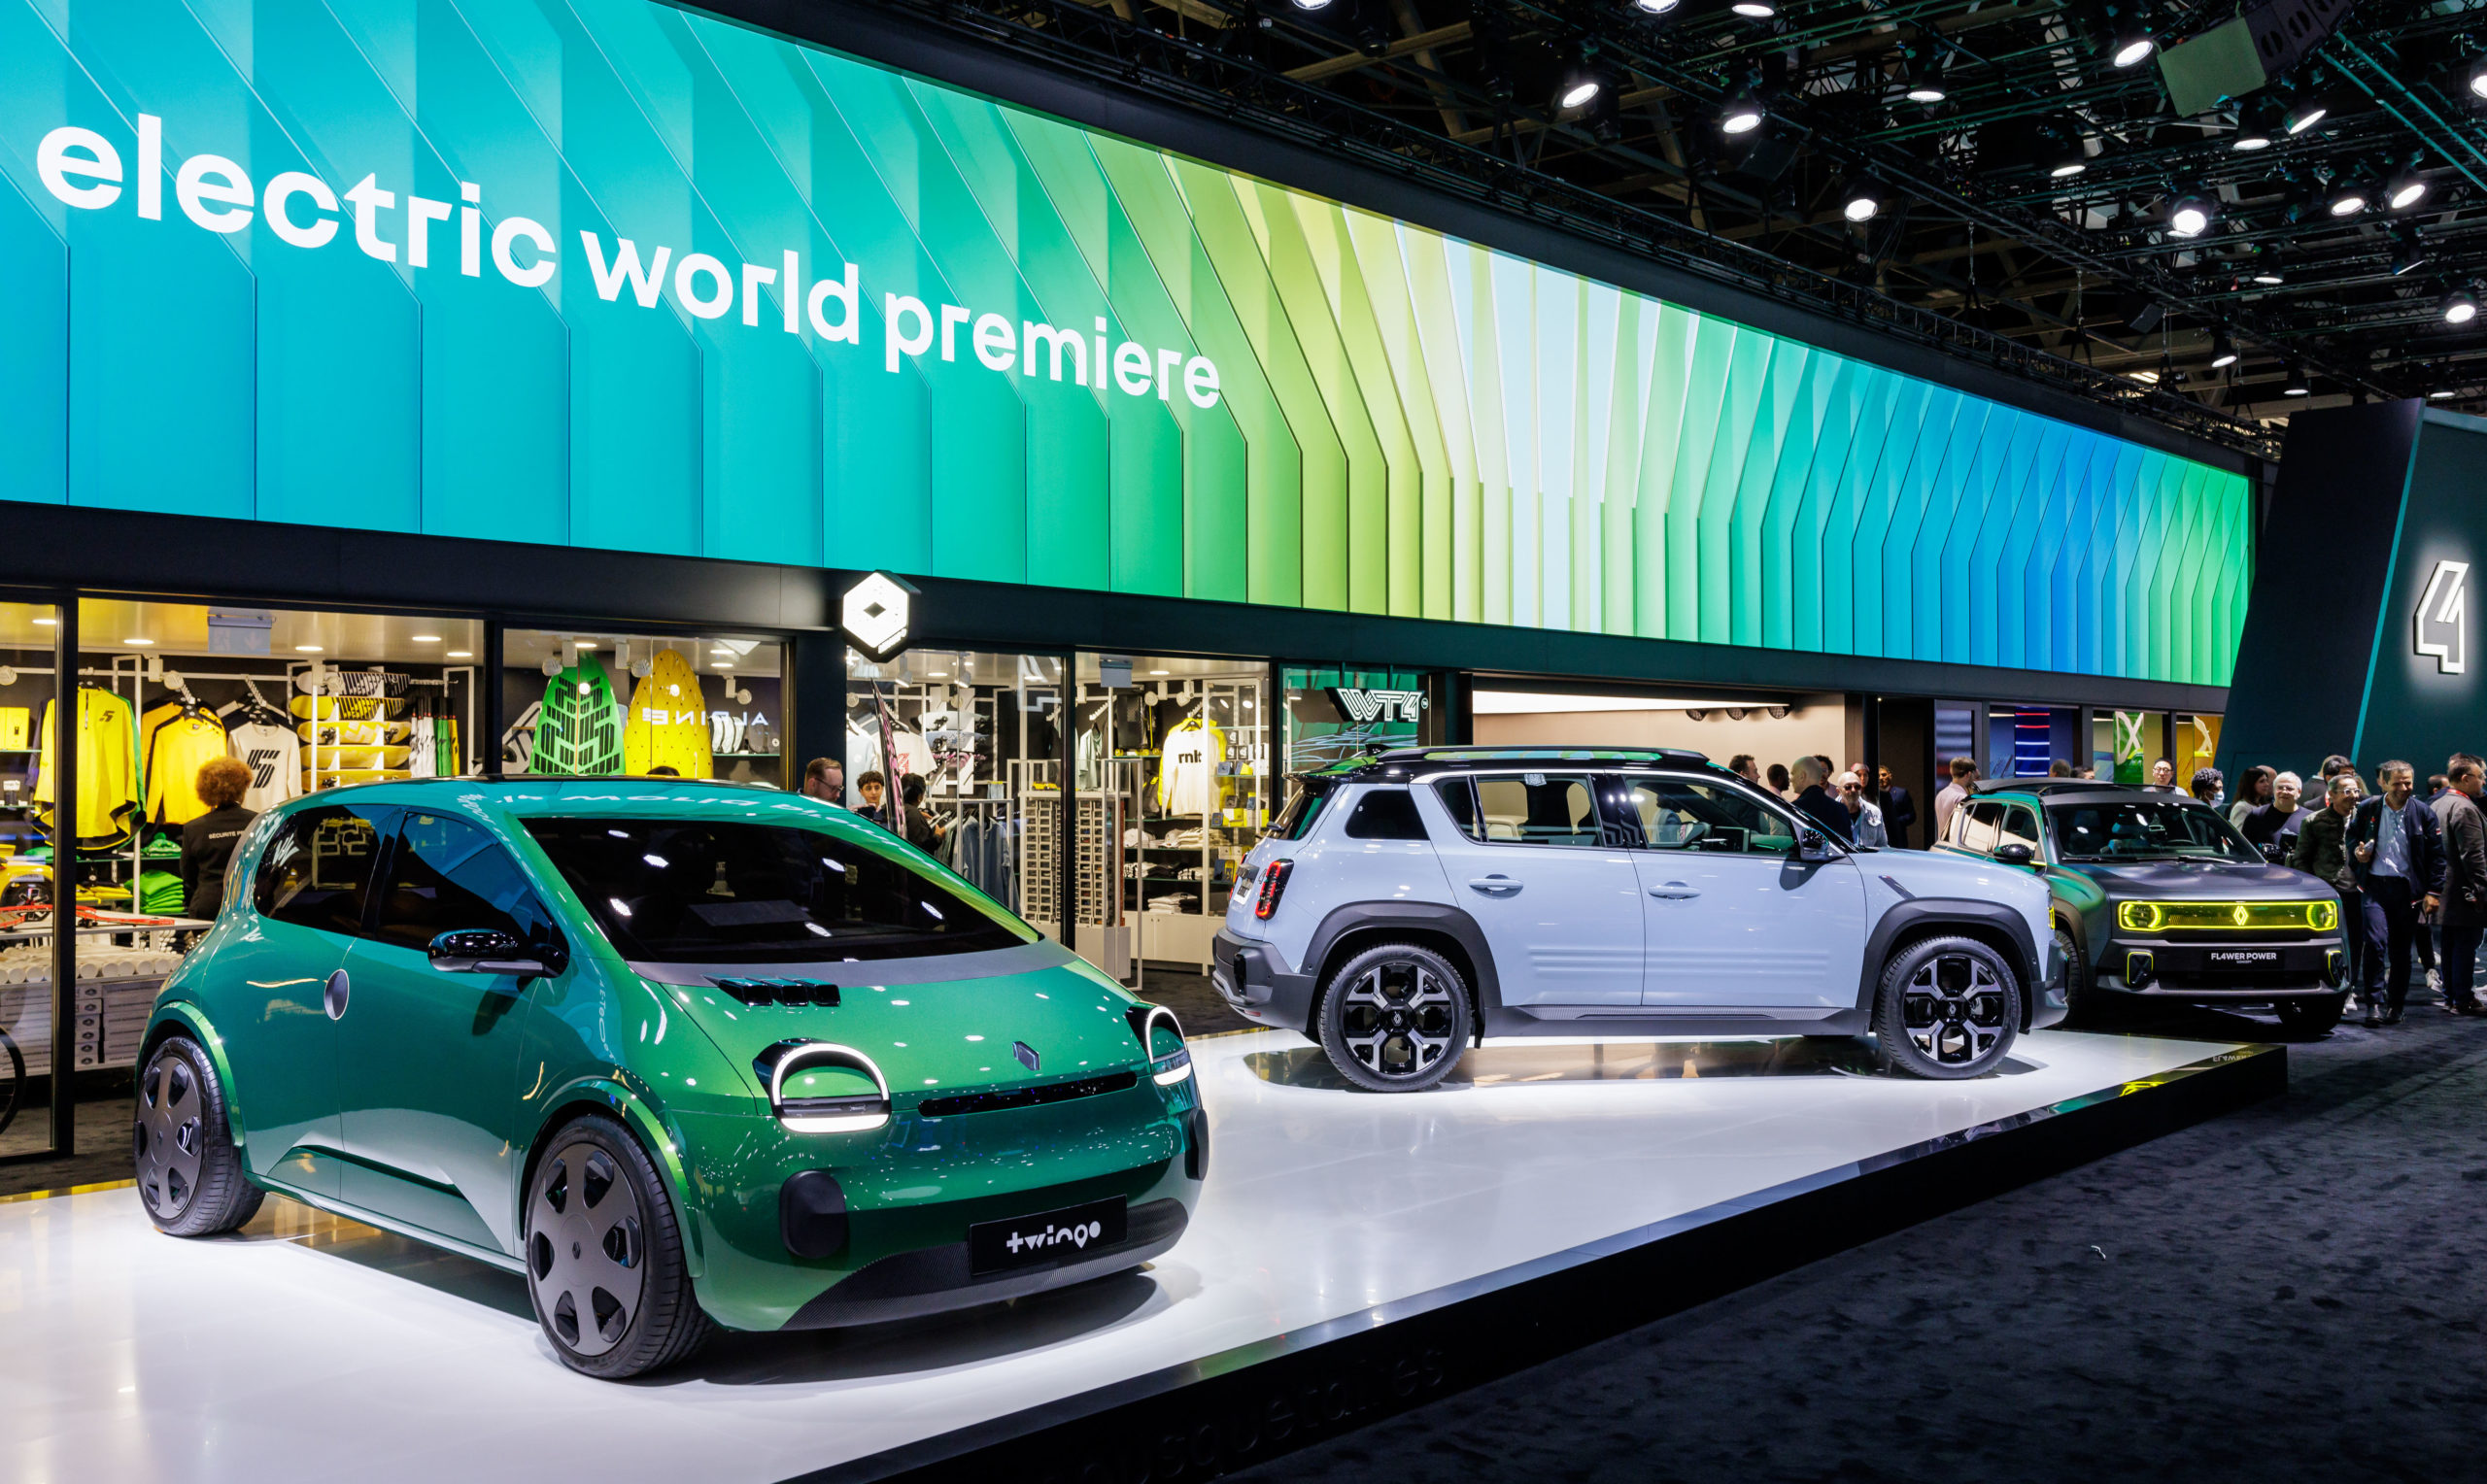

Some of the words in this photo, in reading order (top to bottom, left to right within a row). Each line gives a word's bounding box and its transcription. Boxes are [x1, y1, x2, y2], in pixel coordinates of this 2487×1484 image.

[36, 113, 557, 288] electric
[579, 230, 860, 346] world
[884, 292, 1221, 409] premiere
[2415, 559, 2470, 674] 4
[1337, 688, 1422, 723] WT4
[1177, 749, 1203, 764] rnlt
[2211, 952, 2245, 961] FL4WER
[2246, 952, 2276, 961] POWER
[1005, 1220, 1102, 1254] twingo
